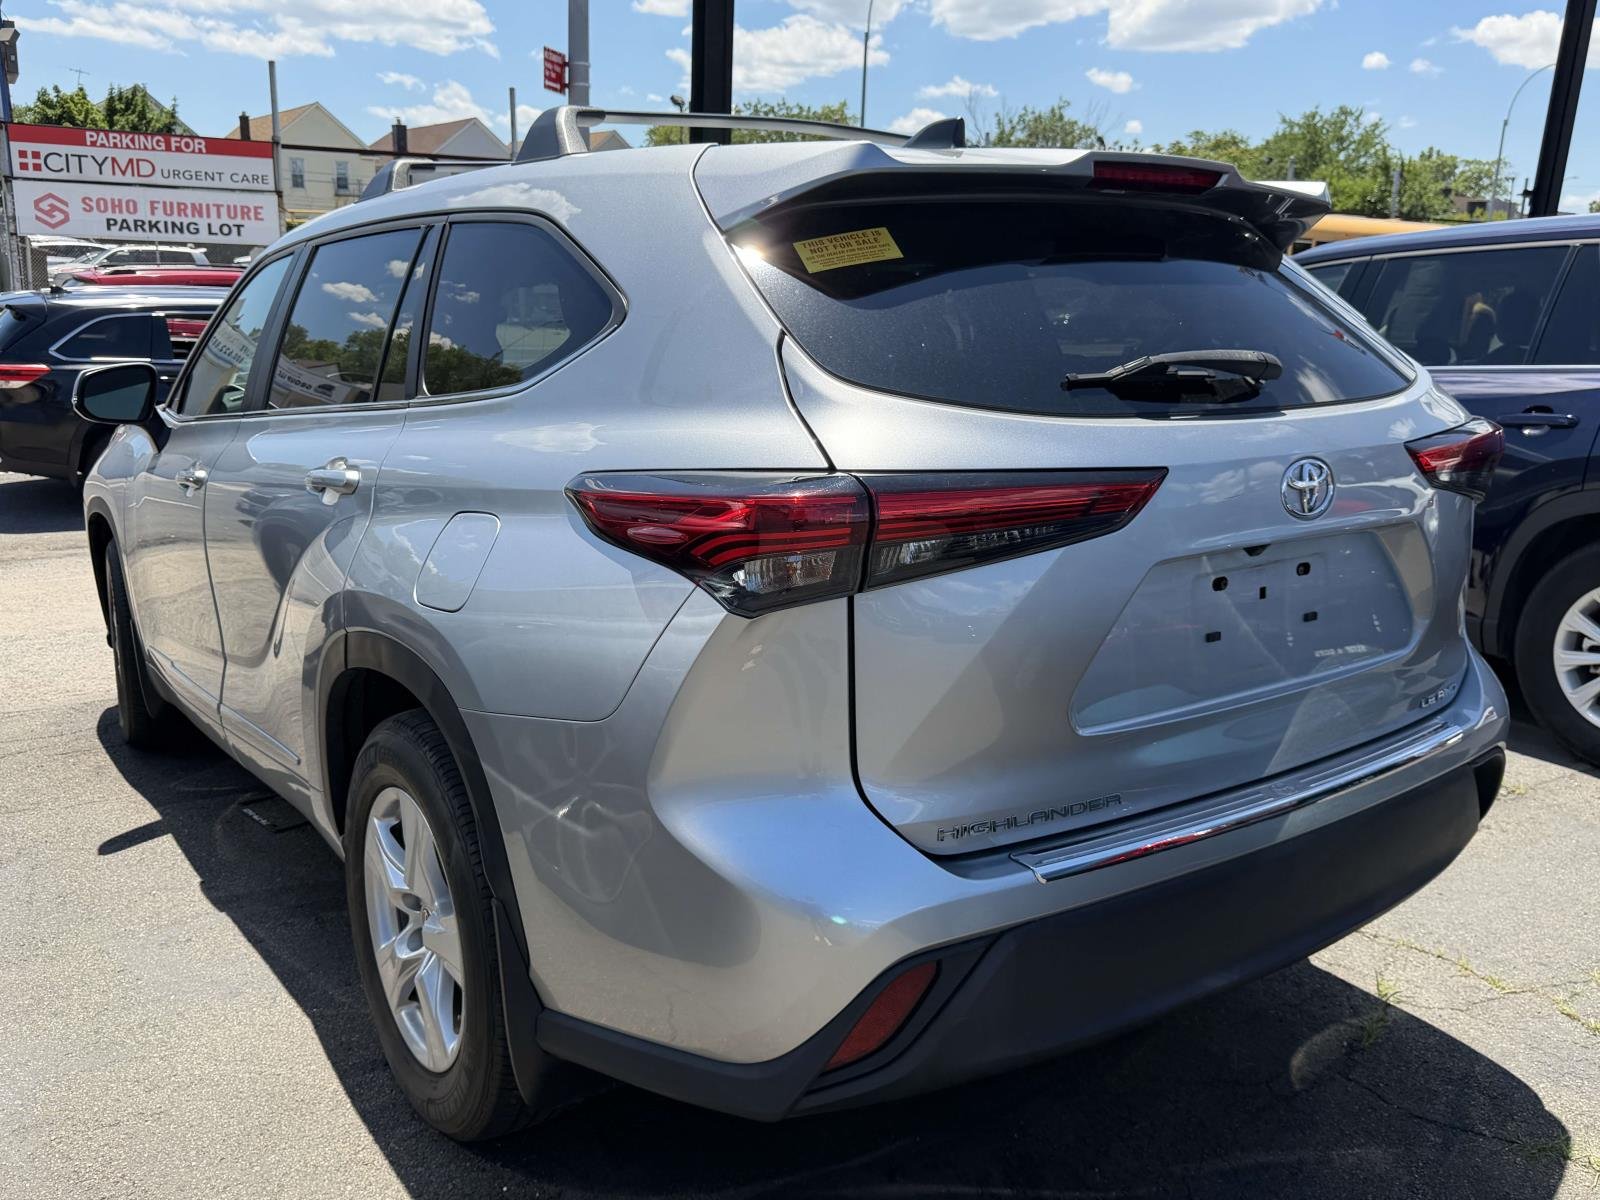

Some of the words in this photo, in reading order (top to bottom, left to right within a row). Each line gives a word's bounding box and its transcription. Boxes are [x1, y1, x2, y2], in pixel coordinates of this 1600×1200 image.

[85, 131, 166, 151] PARKING
[171, 136, 207, 154] FOR
[43, 151, 156, 178] CITYMD
[161, 168, 225, 182] URGENT
[230, 173, 270, 185] CARE
[80, 196, 138, 215] SOHO
[150, 199, 265, 221] FURNITURE
[106, 218, 200, 236] PARKING
[208, 223, 245, 237] LOT
[802, 240, 825, 249] THIS
[826, 232, 870, 244] VEHICLE
[809, 246, 830, 254] NOT
[833, 241, 853, 250] FOR
[855, 237, 881, 246] SALE
[936, 792, 1123, 842] HIGHLANDER
